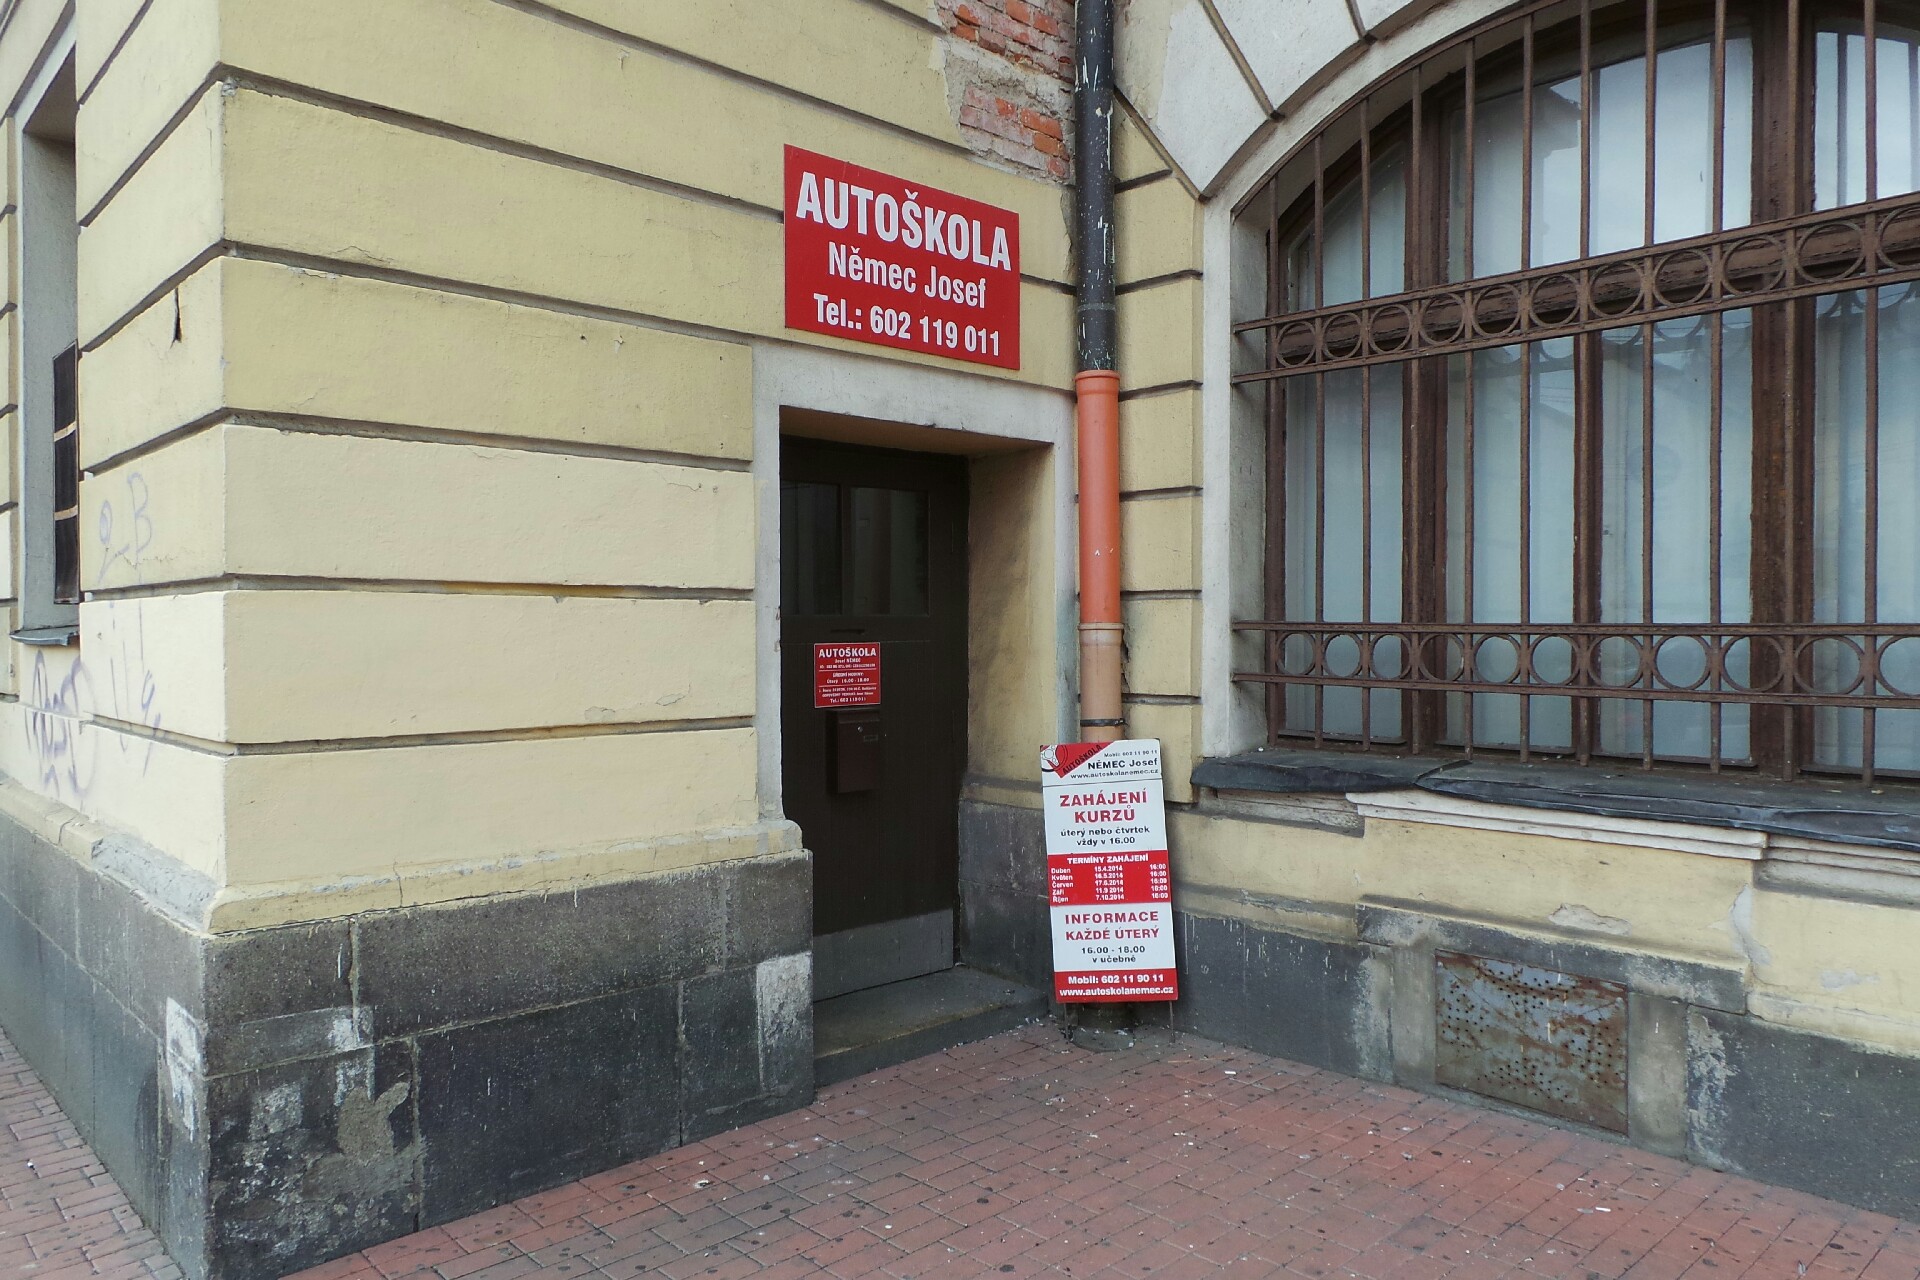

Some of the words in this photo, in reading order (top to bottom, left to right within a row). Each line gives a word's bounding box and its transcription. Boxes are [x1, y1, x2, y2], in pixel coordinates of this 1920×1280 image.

[796, 171, 1012, 271] AUTOŠKOLA
[829, 241, 916, 293] Němec
[925, 266, 986, 308] Josef
[813, 293, 862, 330] Tel.:
[870, 306, 911, 339] 602
[920, 315, 958, 348] 119
[964, 325, 999, 356] 011
[819, 647, 877, 658] AUTOŠKOLA
[1062, 744, 1104, 775] AUTOŠKOLA
[1088, 760, 1126, 770] NĚMEC
[1129, 758, 1158, 767] Josef
[1070, 769, 1158, 779] www.autoskolanemec.cz
[1060, 788, 1148, 807] ZAHÁJENÍ
[1074, 804, 1135, 824] KURZŮ
[1060, 828, 1086, 838] úterý
[1088, 828, 1112, 836] nebo
[1115, 826, 1150, 835] čtvrtek
[1076, 838, 1098, 847] vždy
[1110, 836, 1135, 844] 16.00
[1067, 856, 1104, 864] TERMÍNY
[1107, 853, 1148, 862] ZAHÁJENÍ
[1065, 911, 1158, 924] INFORMACE
[1066, 928, 1110, 940] KAŽDÉ
[1115, 925, 1160, 939] ÚTERÝ
[1068, 976, 1099, 984] Mobil:
[1101, 975, 1120, 984] 602
[1122, 974, 1134, 983] 11
[1137, 974, 1149, 982] 90
[1153, 974, 1164, 982] 11
[1059, 986, 1174, 996] www.autoskolanemec.cz
